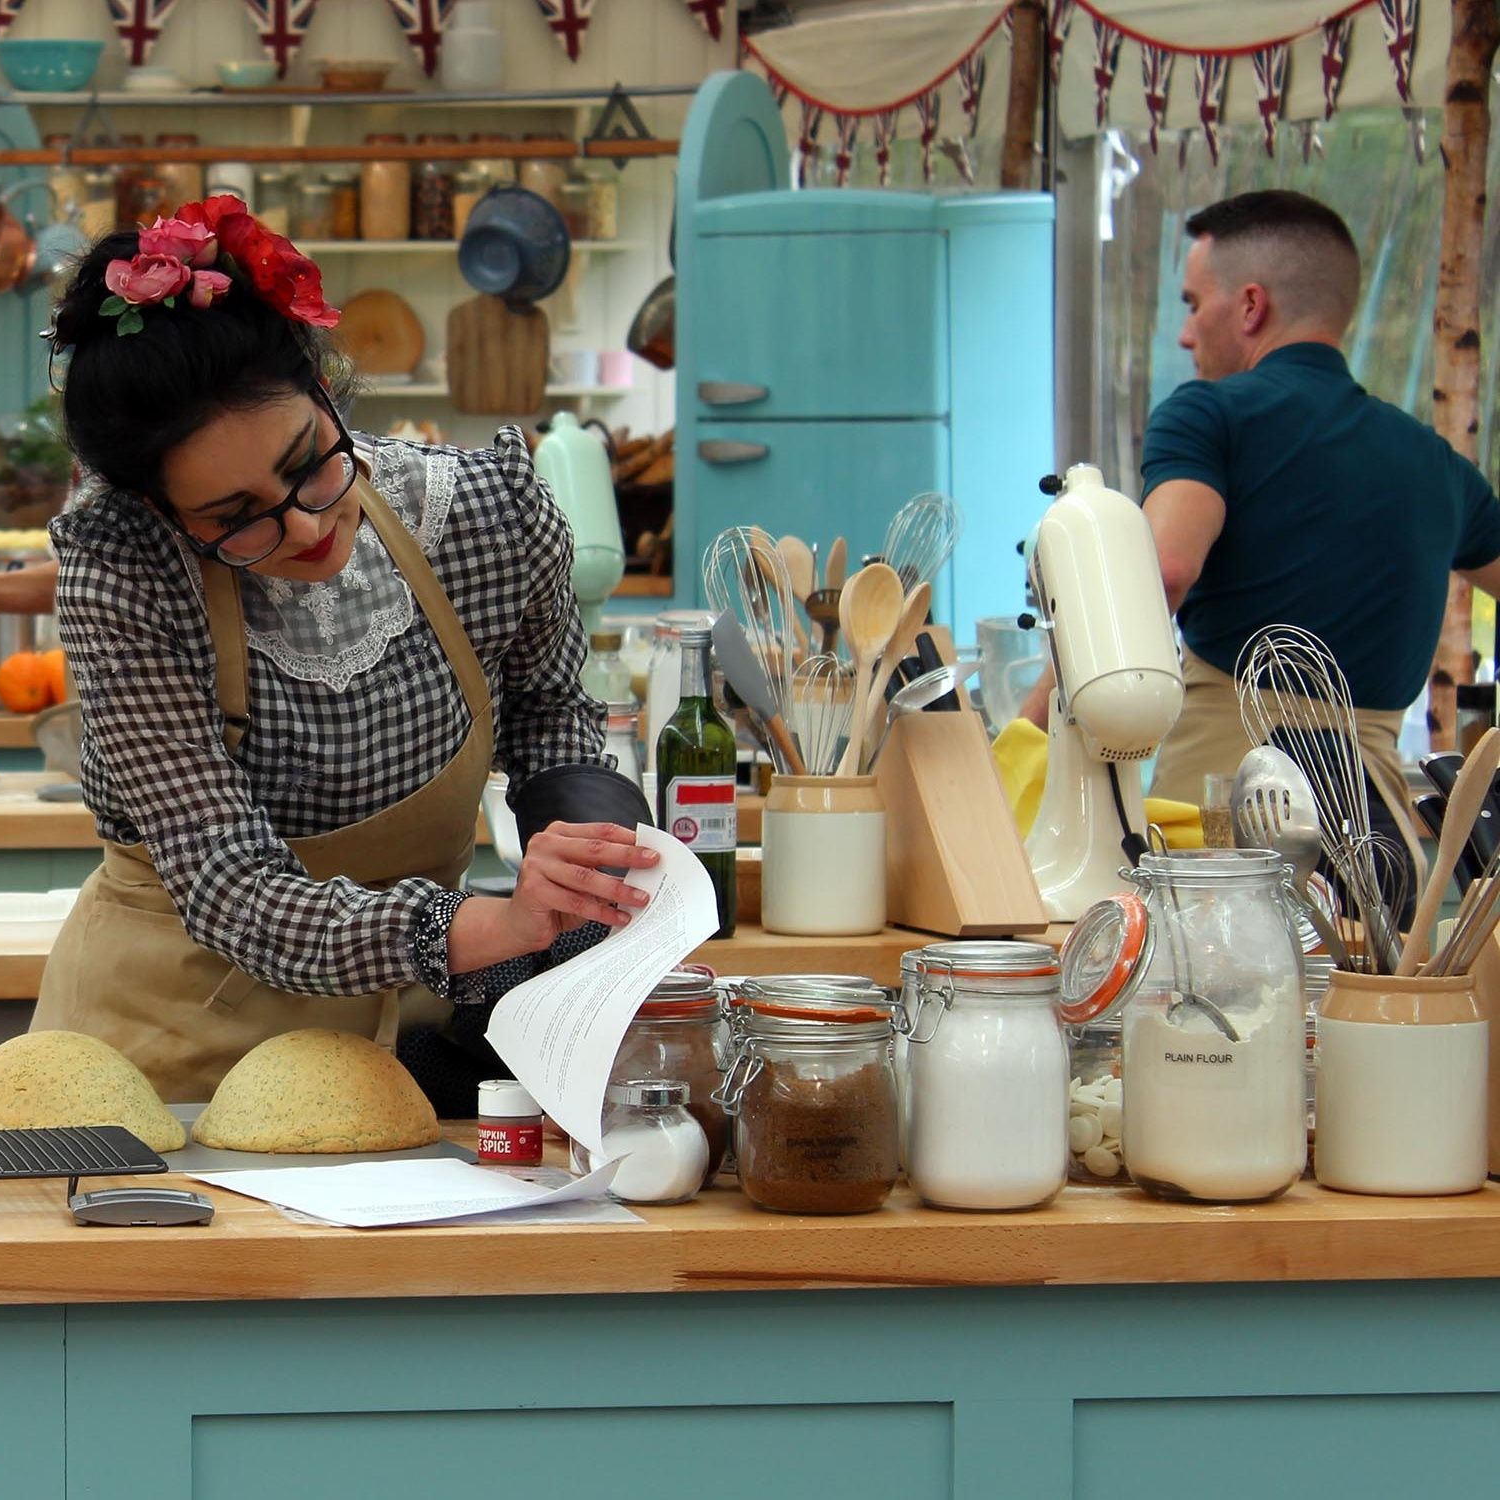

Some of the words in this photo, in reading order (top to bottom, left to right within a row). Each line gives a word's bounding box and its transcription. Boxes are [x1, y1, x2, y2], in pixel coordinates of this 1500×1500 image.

[1164, 1052, 1194, 1063] PLAIN
[1196, 1053, 1233, 1064] FLOUR
[478, 1129, 507, 1141] UMPKIN
[482, 1139, 512, 1153] SPICE
